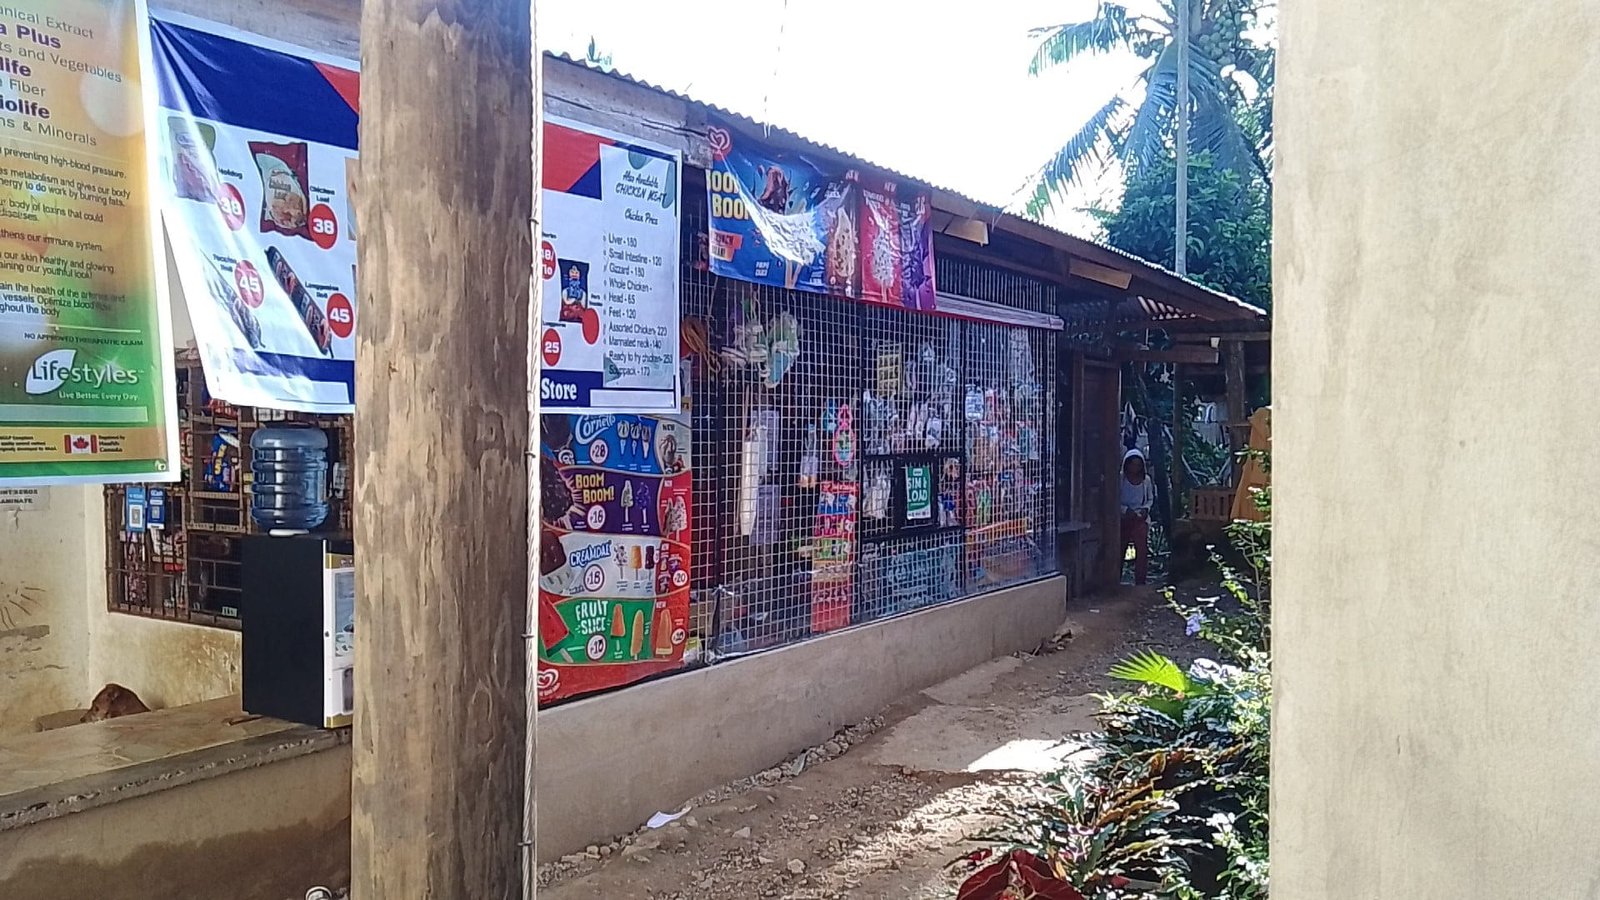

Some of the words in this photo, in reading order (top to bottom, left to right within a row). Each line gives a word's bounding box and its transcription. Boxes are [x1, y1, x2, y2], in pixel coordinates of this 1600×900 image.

[47, 17, 94, 39] Extract
[17, 24, 61, 49] Plus
[19, 47, 45, 61] and
[51, 54, 122, 83] Vegetables
[10, 79, 46, 97] Fiber
[23, 121, 32, 132] &
[39, 123, 97, 146] Minerals
[4, 148, 48, 164] preventing
[51, 155, 91, 171] high-blood
[10, 169, 58, 183] metabolism
[61, 178, 74, 187] and
[77, 182, 95, 193] gives
[98, 185, 110, 195] our
[112, 187, 131, 199] body
[705, 168, 740, 194] OO
[25, 181, 33, 189] to
[35, 182, 46, 192] do
[49, 186, 67, 196] work
[69, 189, 78, 200] by
[80, 191, 107, 206] burning
[616, 183, 645, 198] CHICKEN
[647, 191, 668, 203] MEAT
[9, 199, 30, 211] body
[32, 203, 41, 212] of
[43, 204, 66, 216] toxins
[68, 210, 82, 220] that
[84, 213, 104, 223] could
[220, 198, 242, 215] 38
[312, 218, 334, 234] 38
[27, 233, 41, 243] our
[43, 235, 74, 248] immune
[608, 233, 623, 246] Liver
[4, 252, 19, 260] our
[20, 252, 38, 263] skin
[39, 255, 68, 270] healthy
[70, 260, 84, 269] and
[86, 263, 114, 275] glowing
[609, 248, 624, 260] Small
[625, 250, 648, 264] Intestine
[27, 264, 41, 273] our
[42, 266, 73, 278] youthful
[609, 263, 630, 276] Gizzard
[15, 282, 29, 292] the
[31, 284, 56, 296] health
[57, 287, 65, 297] of
[67, 288, 79, 298] the
[240, 277, 259, 293] 45
[609, 278, 626, 290] Whole
[627, 280, 649, 293] Chicken
[3, 293, 34, 304] vessels
[74, 298, 95, 309] blood
[609, 293, 624, 304] Head
[627, 294, 636, 305] 65
[26, 304, 39, 314] the
[41, 306, 60, 318] body
[330, 308, 350, 323] 45
[609, 307, 621, 318] Feet
[24, 332, 36, 340] NO
[609, 322, 634, 334] Assorted
[544, 341, 560, 354] 25
[637, 339, 649, 349] neck
[609, 350, 627, 364] Ready
[628, 351, 634, 361] to
[32, 360, 139, 388] Lifestyles
[59, 391, 74, 399] Live
[101, 393, 121, 402] Every
[541, 378, 577, 400] Store
[662, 423, 675, 431] NEW
[575, 473, 604, 488] BOOM
[908, 477, 922, 489] SIM
[583, 486, 615, 504] BOOM!
[908, 489, 928, 503] LOAD
[575, 600, 608, 620] FRUIT
[580, 617, 606, 635] SLICE
